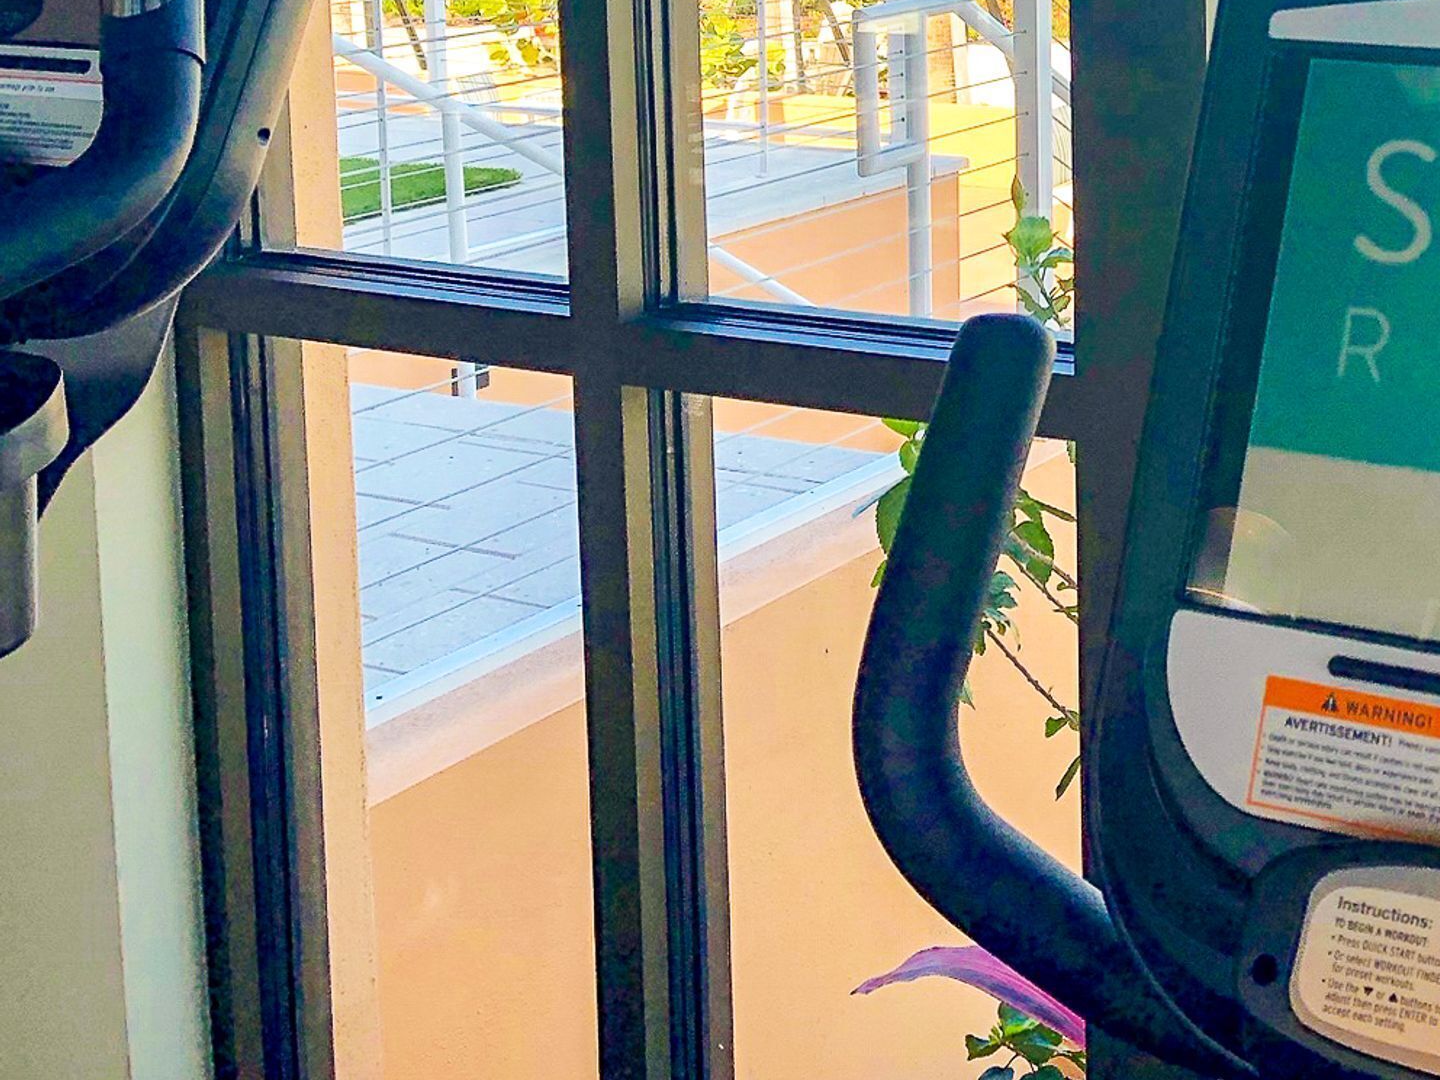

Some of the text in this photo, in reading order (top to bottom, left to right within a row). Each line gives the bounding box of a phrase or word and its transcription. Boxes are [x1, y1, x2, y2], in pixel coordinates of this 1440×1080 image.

[1346, 699, 1433, 730] WARNING!
[1284, 716, 1394, 748] AVERTISSEMENT!
[1334, 917, 1346, 928] TO
[1347, 919, 1374, 934] BEGIN
[1375, 927, 1382, 935] A
[1337, 896, 1434, 929] Instructions:
[1337, 934, 1360, 948] Press
[1362, 939, 1388, 954] QUICK
[1389, 945, 1415, 960] START
[1373, 959, 1414, 976] WORKOUT
